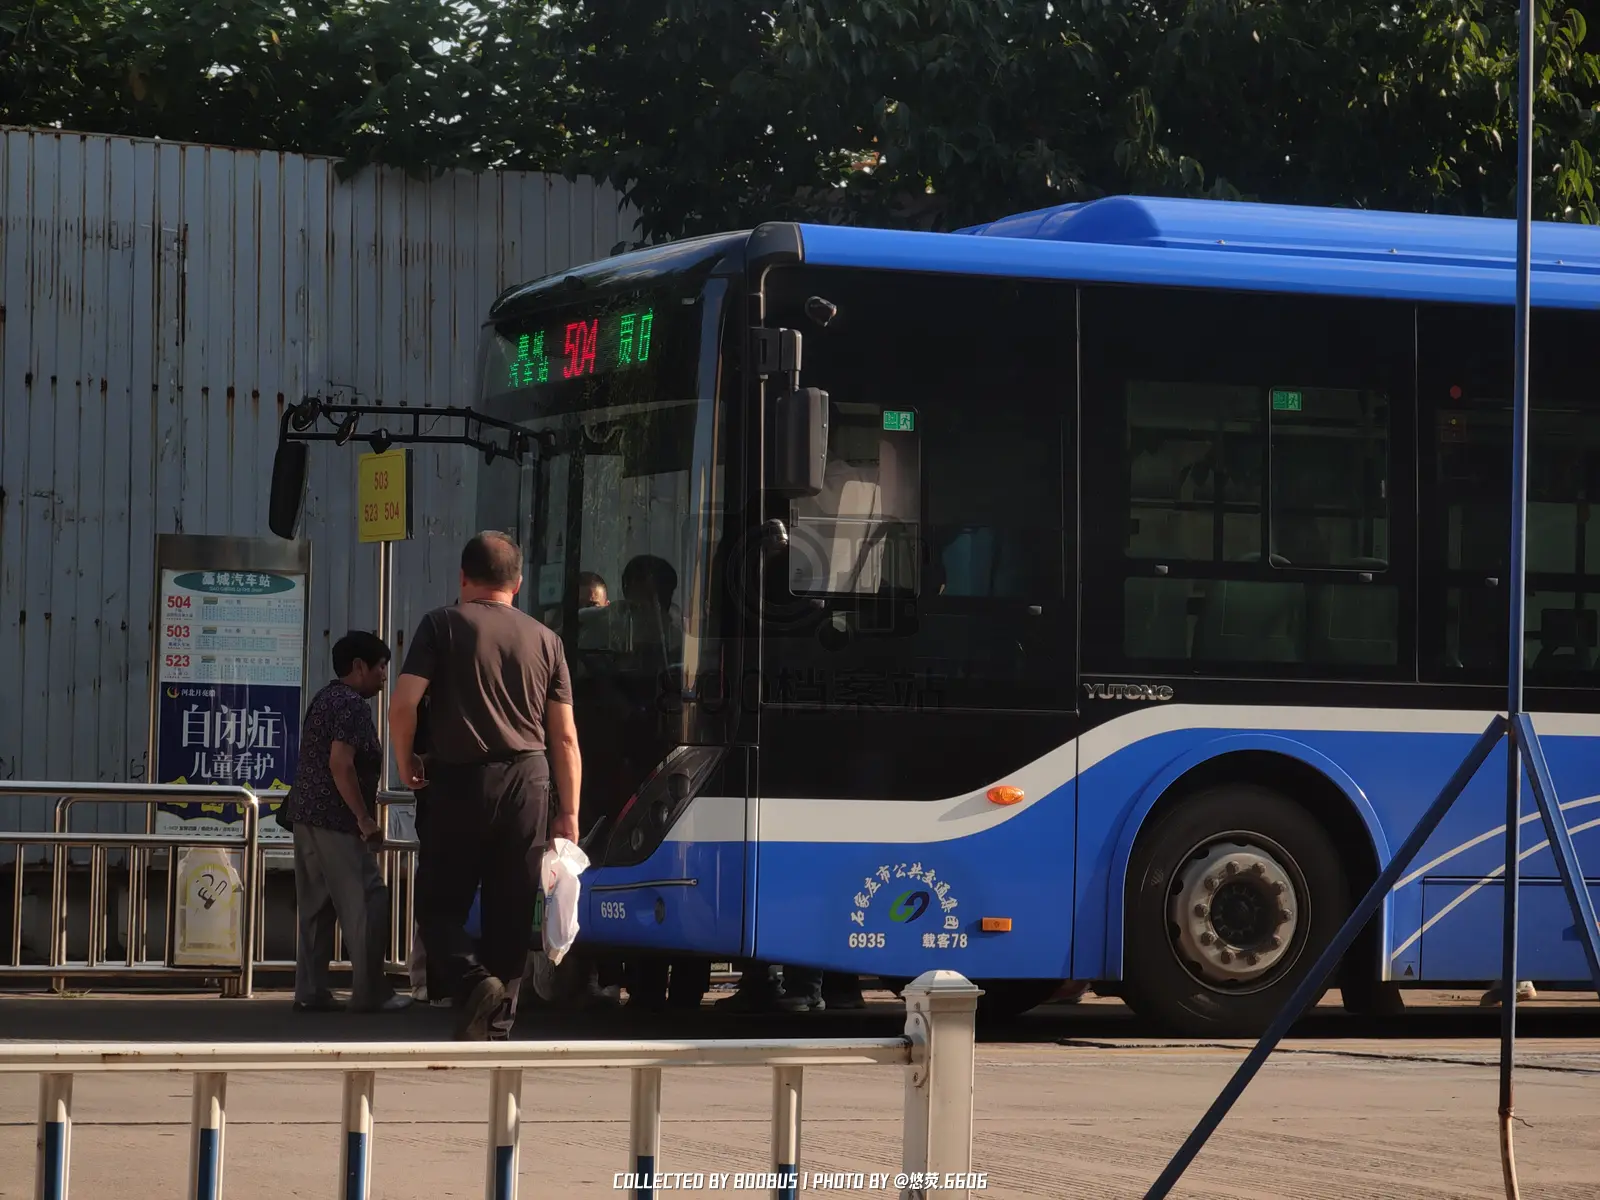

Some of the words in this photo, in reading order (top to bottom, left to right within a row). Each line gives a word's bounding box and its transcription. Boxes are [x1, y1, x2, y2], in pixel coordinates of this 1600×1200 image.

[563, 318, 599, 378] 504
[374, 470, 389, 491] 503
[364, 503, 379, 522] 523
[384, 501, 400, 520] 504
[202, 572, 271, 588] 藁城汽车站
[167, 596, 191, 609] 504
[166, 625, 191, 638] 503
[165, 654, 190, 667] 523
[1083, 683, 1174, 701] YUTONG
[182, 704, 282, 749] 自闭症
[189, 751, 275, 780] 儿童看护
[851, 862, 959, 929] 石家庄市公共交通集团
[601, 901, 626, 919] 6935
[849, 933, 885, 948] 6935
[922, 933, 968, 948] 载客78
